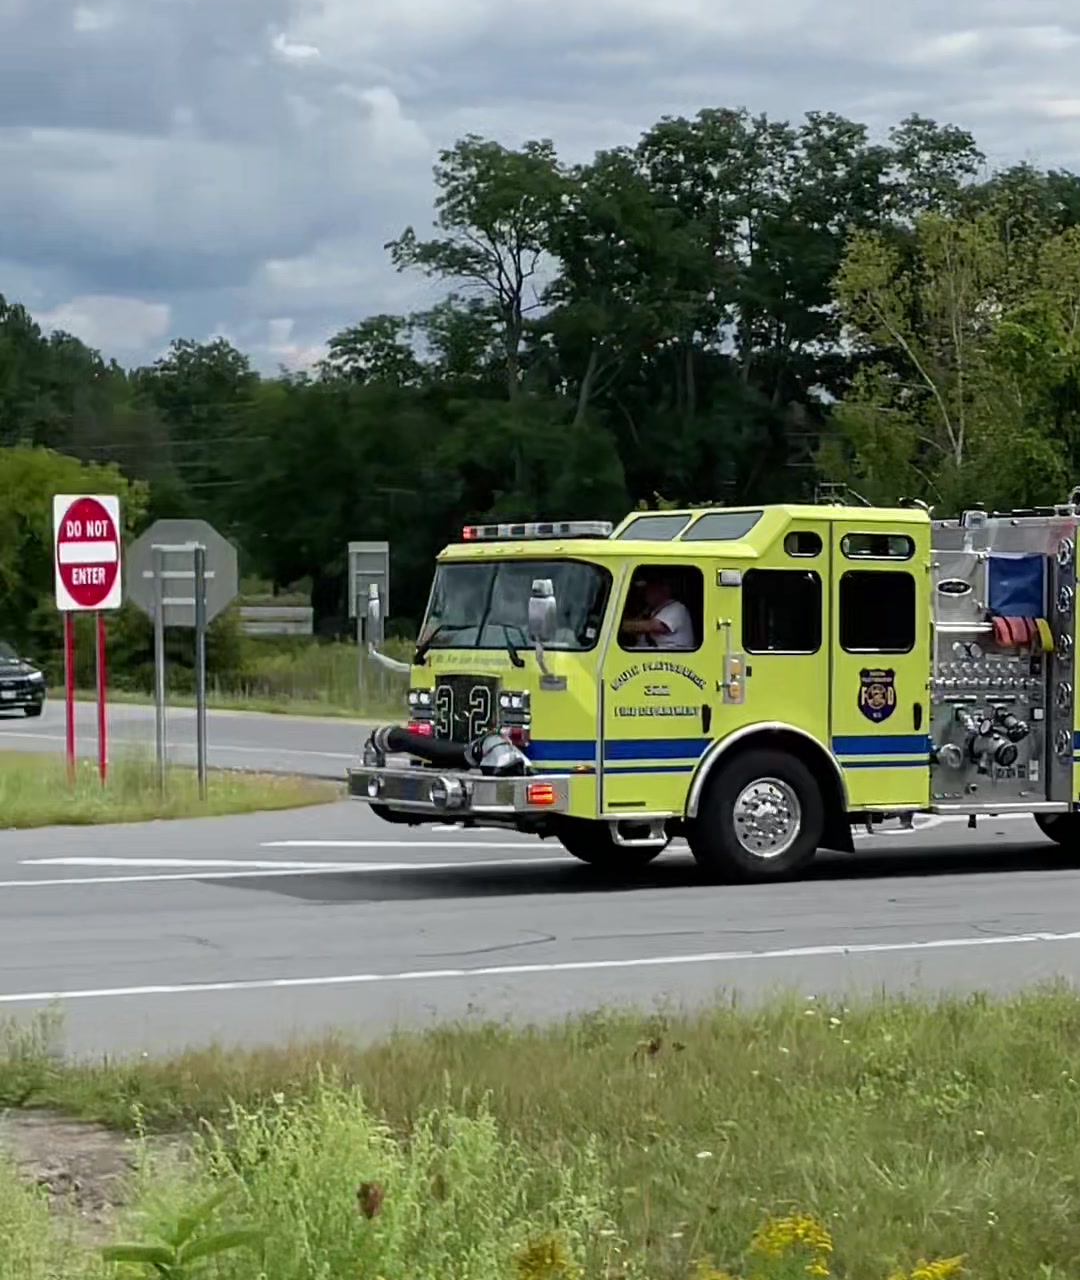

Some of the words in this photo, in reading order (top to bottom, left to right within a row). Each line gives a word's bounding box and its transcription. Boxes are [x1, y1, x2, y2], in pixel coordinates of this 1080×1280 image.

[66, 520, 82, 537] DO
[86, 520, 108, 537] NOT
[72, 567, 106, 585] ENTER
[436, 685, 491, 741] 32
